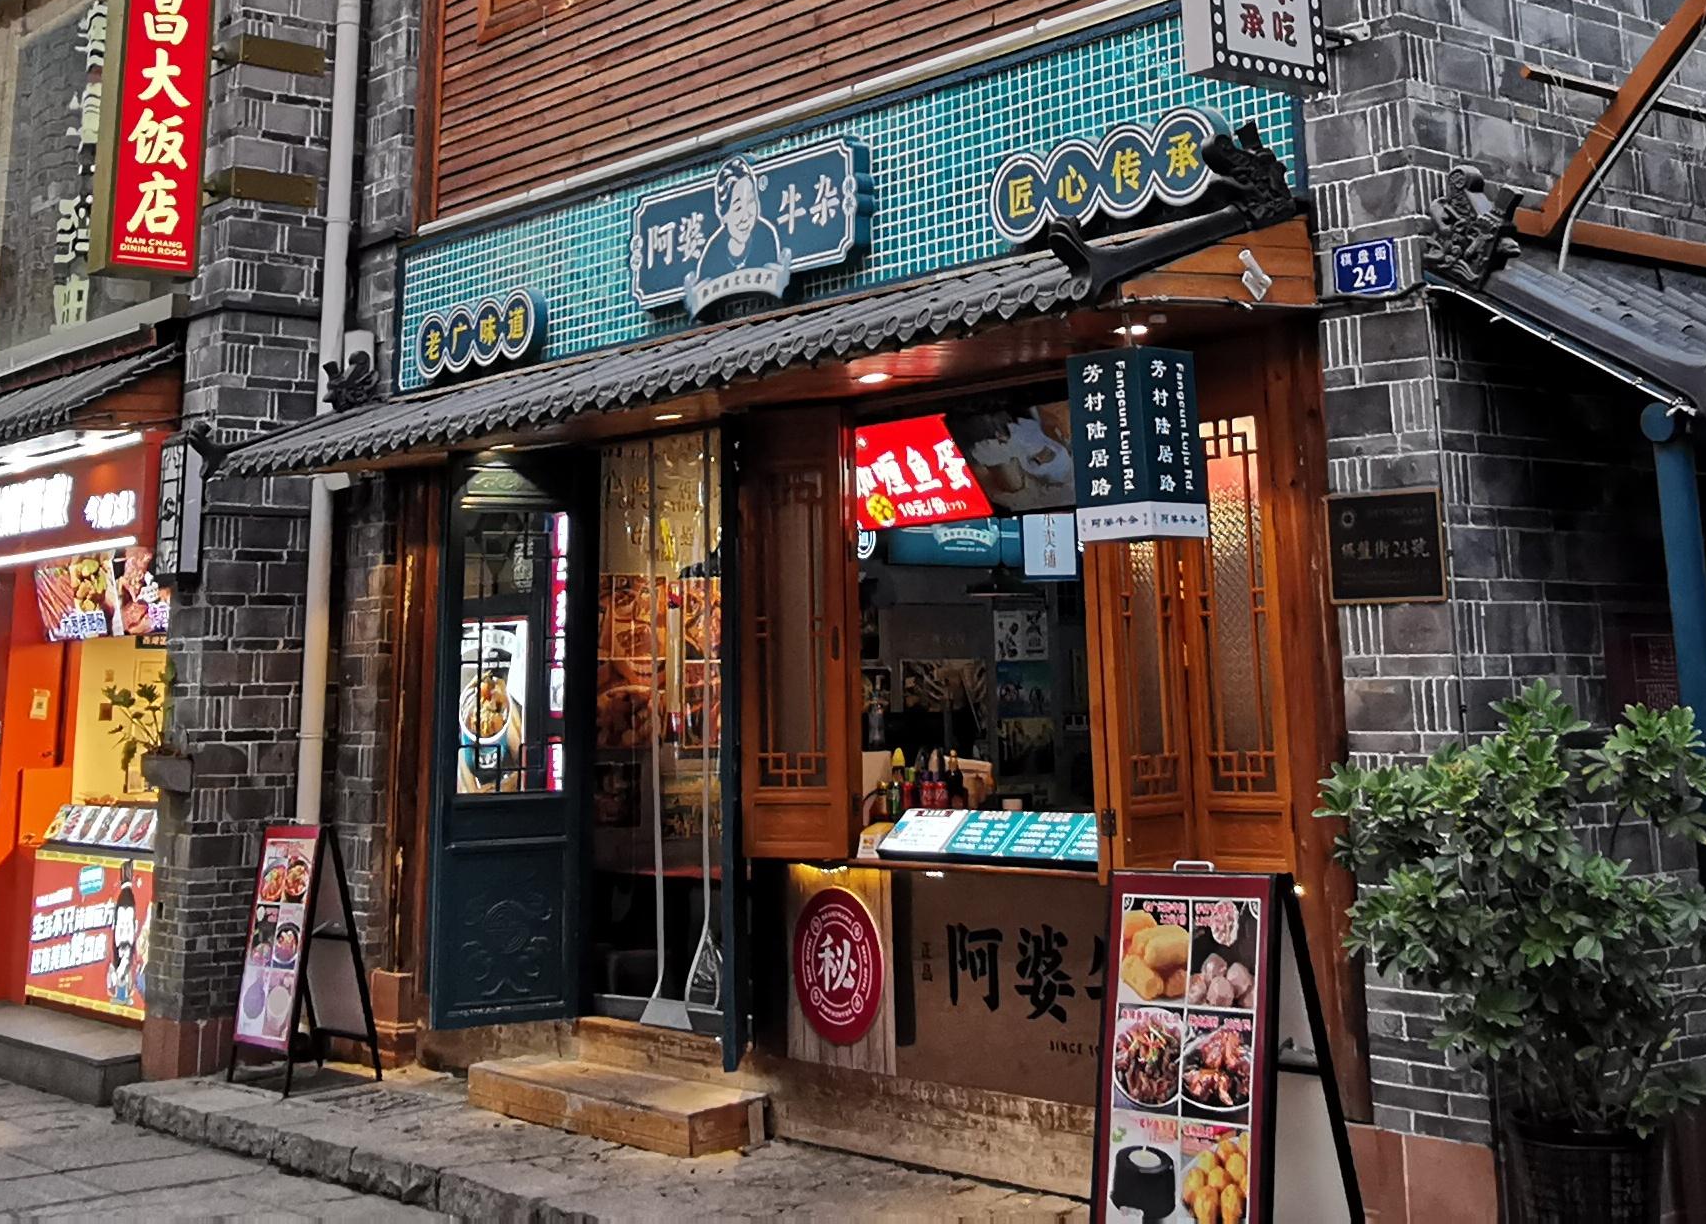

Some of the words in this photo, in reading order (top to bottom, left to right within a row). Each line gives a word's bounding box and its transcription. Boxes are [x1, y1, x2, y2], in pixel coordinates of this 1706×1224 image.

[1008, 131, 1199, 219] 匠心传承
[119, 243, 155, 254] DINING
[157, 247, 187, 257] ROOM
[124, 235, 146, 245] NAN
[148, 238, 182, 249] CHANG
[647, 212, 706, 270] 阿婆
[776, 174, 840, 235] 牛杂
[1352, 264, 1377, 288] 24
[425, 307, 526, 361] 老广味道
[1115, 360, 1128, 427] Fangcun
[1175, 362, 1187, 428] Fangcun
[1082, 363, 1112, 497] 芳村陆居路
[1120, 430, 1133, 465] Luju
[1150, 359, 1177, 493] 芳村陆居路
[1180, 432, 1191, 466] Luju
[817, 932, 858, 993] 秘
[1049, 1039, 1083, 1056] SINCE
